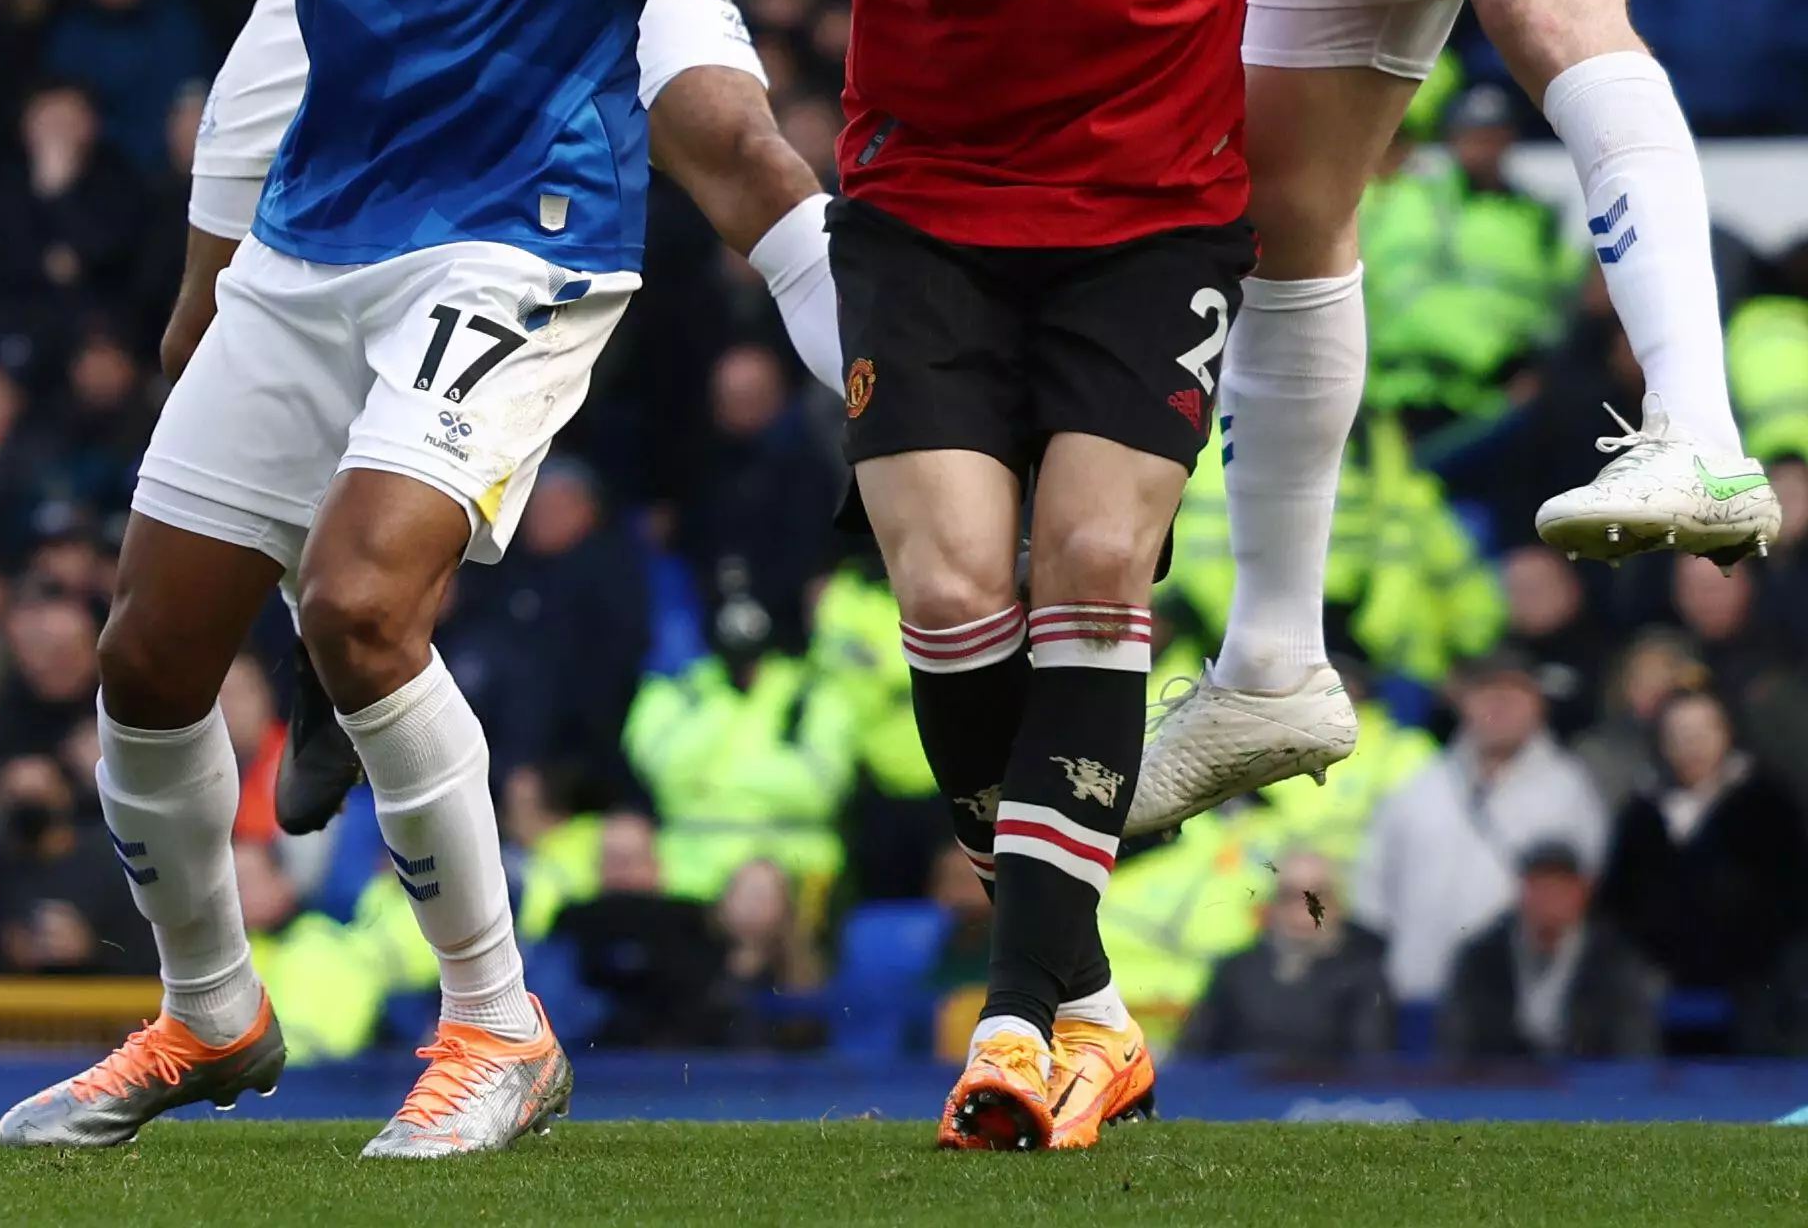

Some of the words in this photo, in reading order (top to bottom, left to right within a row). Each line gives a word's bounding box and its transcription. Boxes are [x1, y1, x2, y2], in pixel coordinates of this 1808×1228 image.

[412, 303, 529, 404] 17
[1174, 287, 1229, 397] 2
[423, 432, 470, 463] hummel
